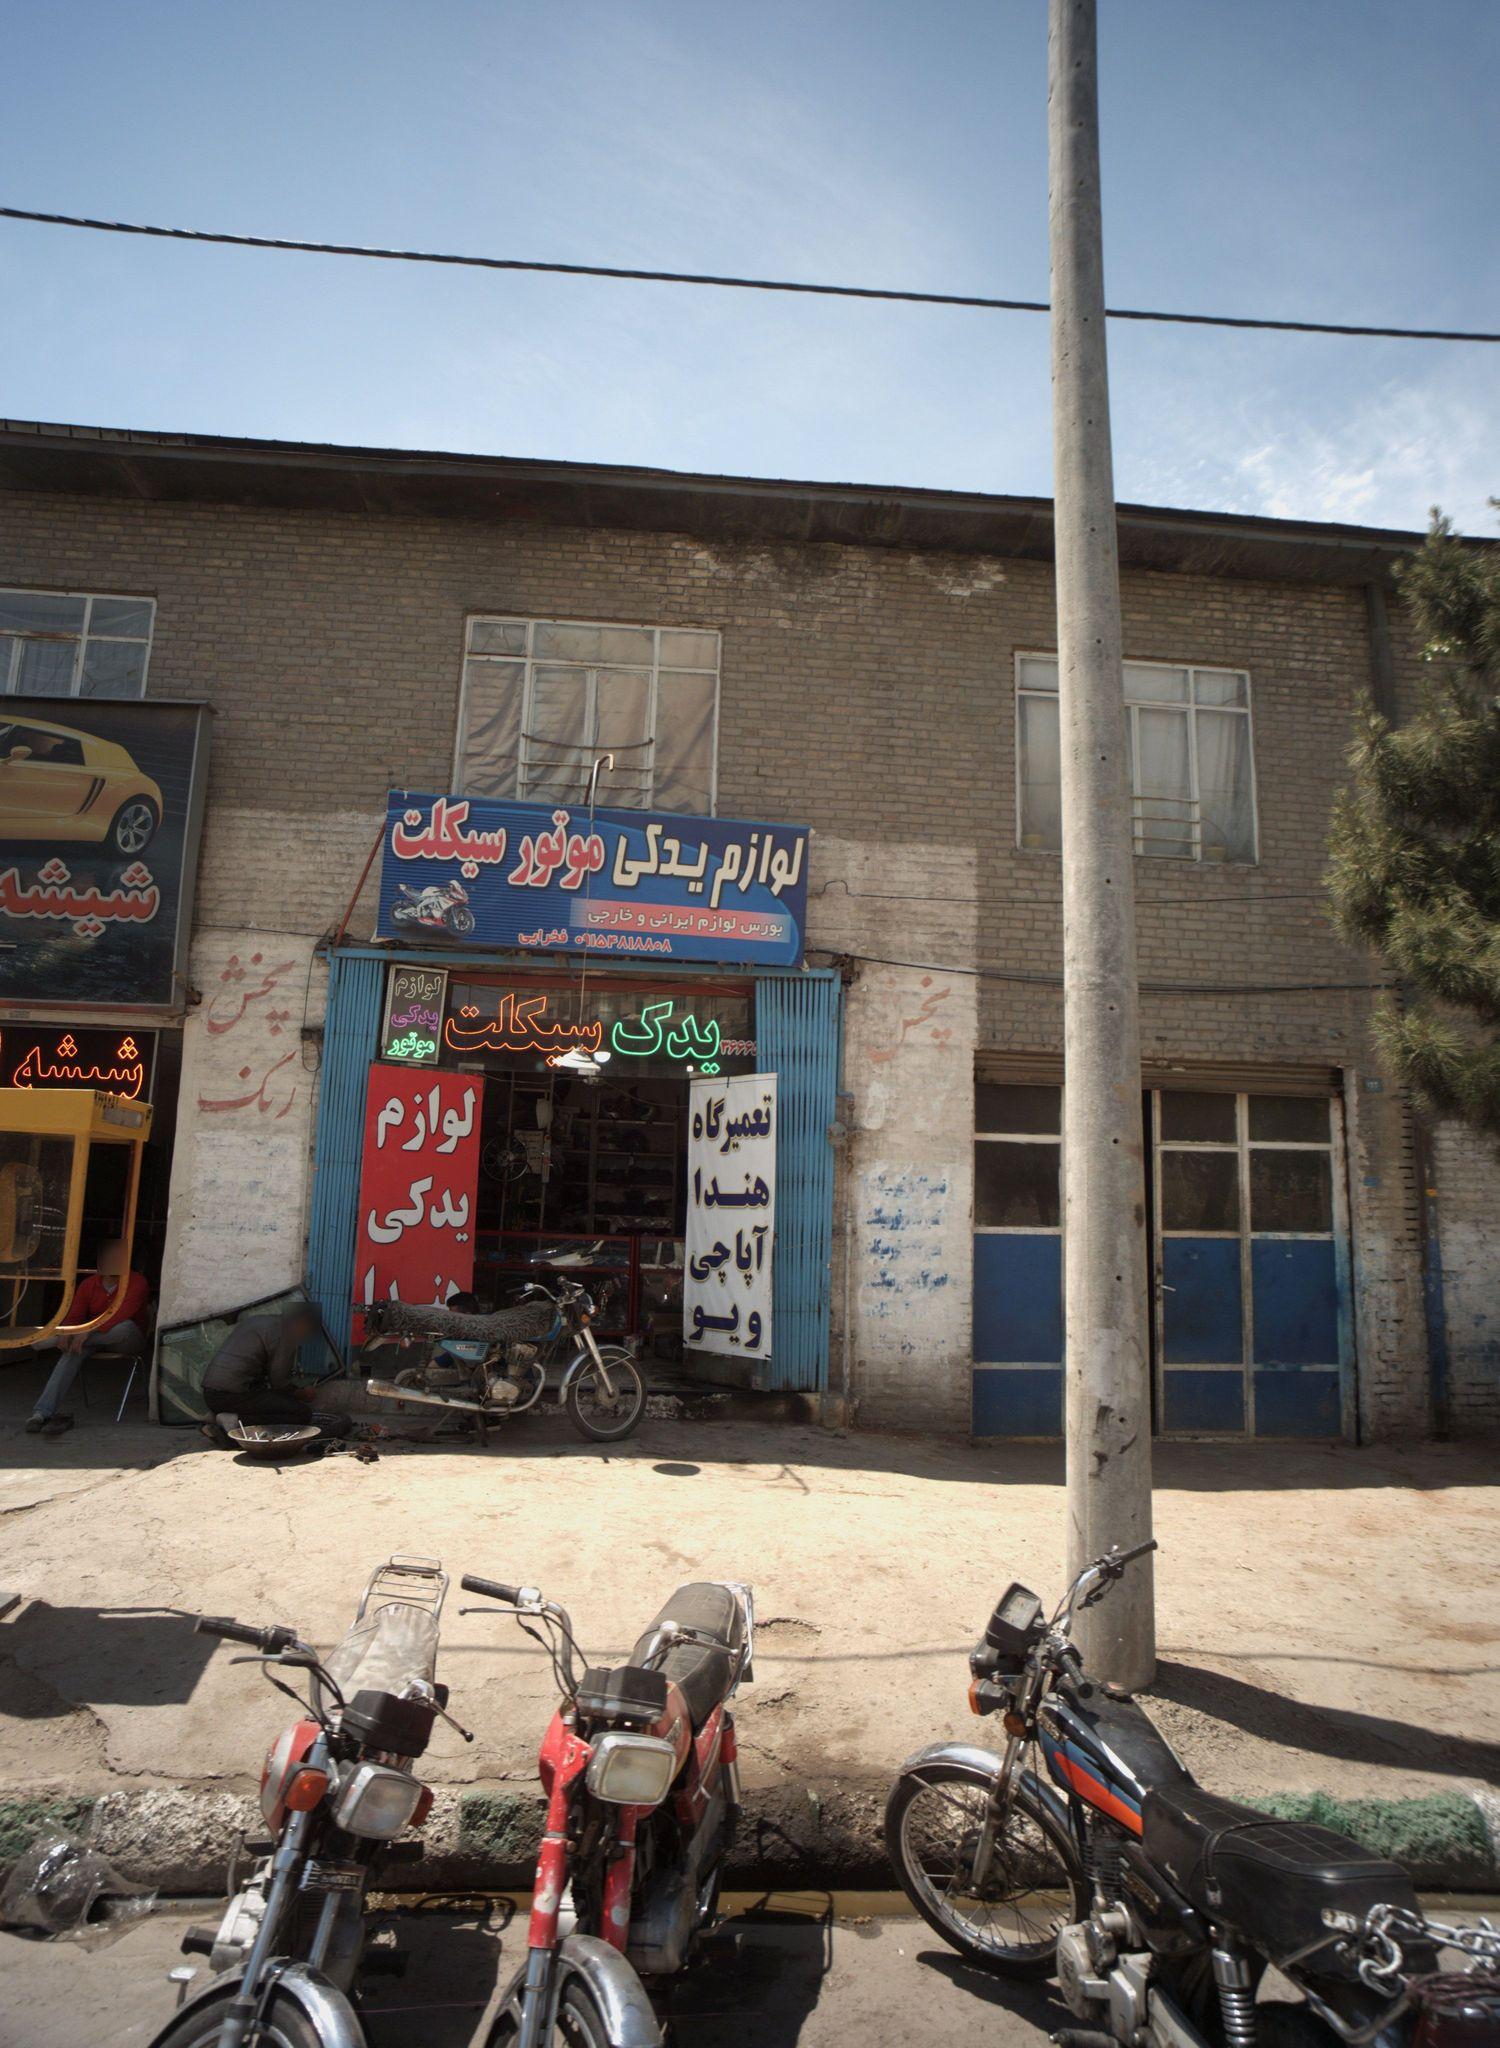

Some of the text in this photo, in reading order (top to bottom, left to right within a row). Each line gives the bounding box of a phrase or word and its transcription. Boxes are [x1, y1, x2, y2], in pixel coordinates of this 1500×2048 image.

[391, 797, 805, 909] لوازم یدکی موتور سیکلت
[518, 927, 569, 947] فخرایی
[587, 907, 783, 937] بورس لوازم ایرانی و خارجی
[207, 952, 296, 1037] پخش
[390, 1004, 439, 1031] یدکی
[394, 973, 442, 1001] لوازم
[386, 1031, 436, 1058] موتور
[445, 992, 720, 1075] یدک سیکلت
[377, 1082, 477, 1155] لوازم
[692, 1094, 773, 1155] تعمیرگاه
[366, 1175, 471, 1244] یدکی
[693, 1166, 771, 1209] هندا
[689, 1224, 770, 1288] آپاچی
